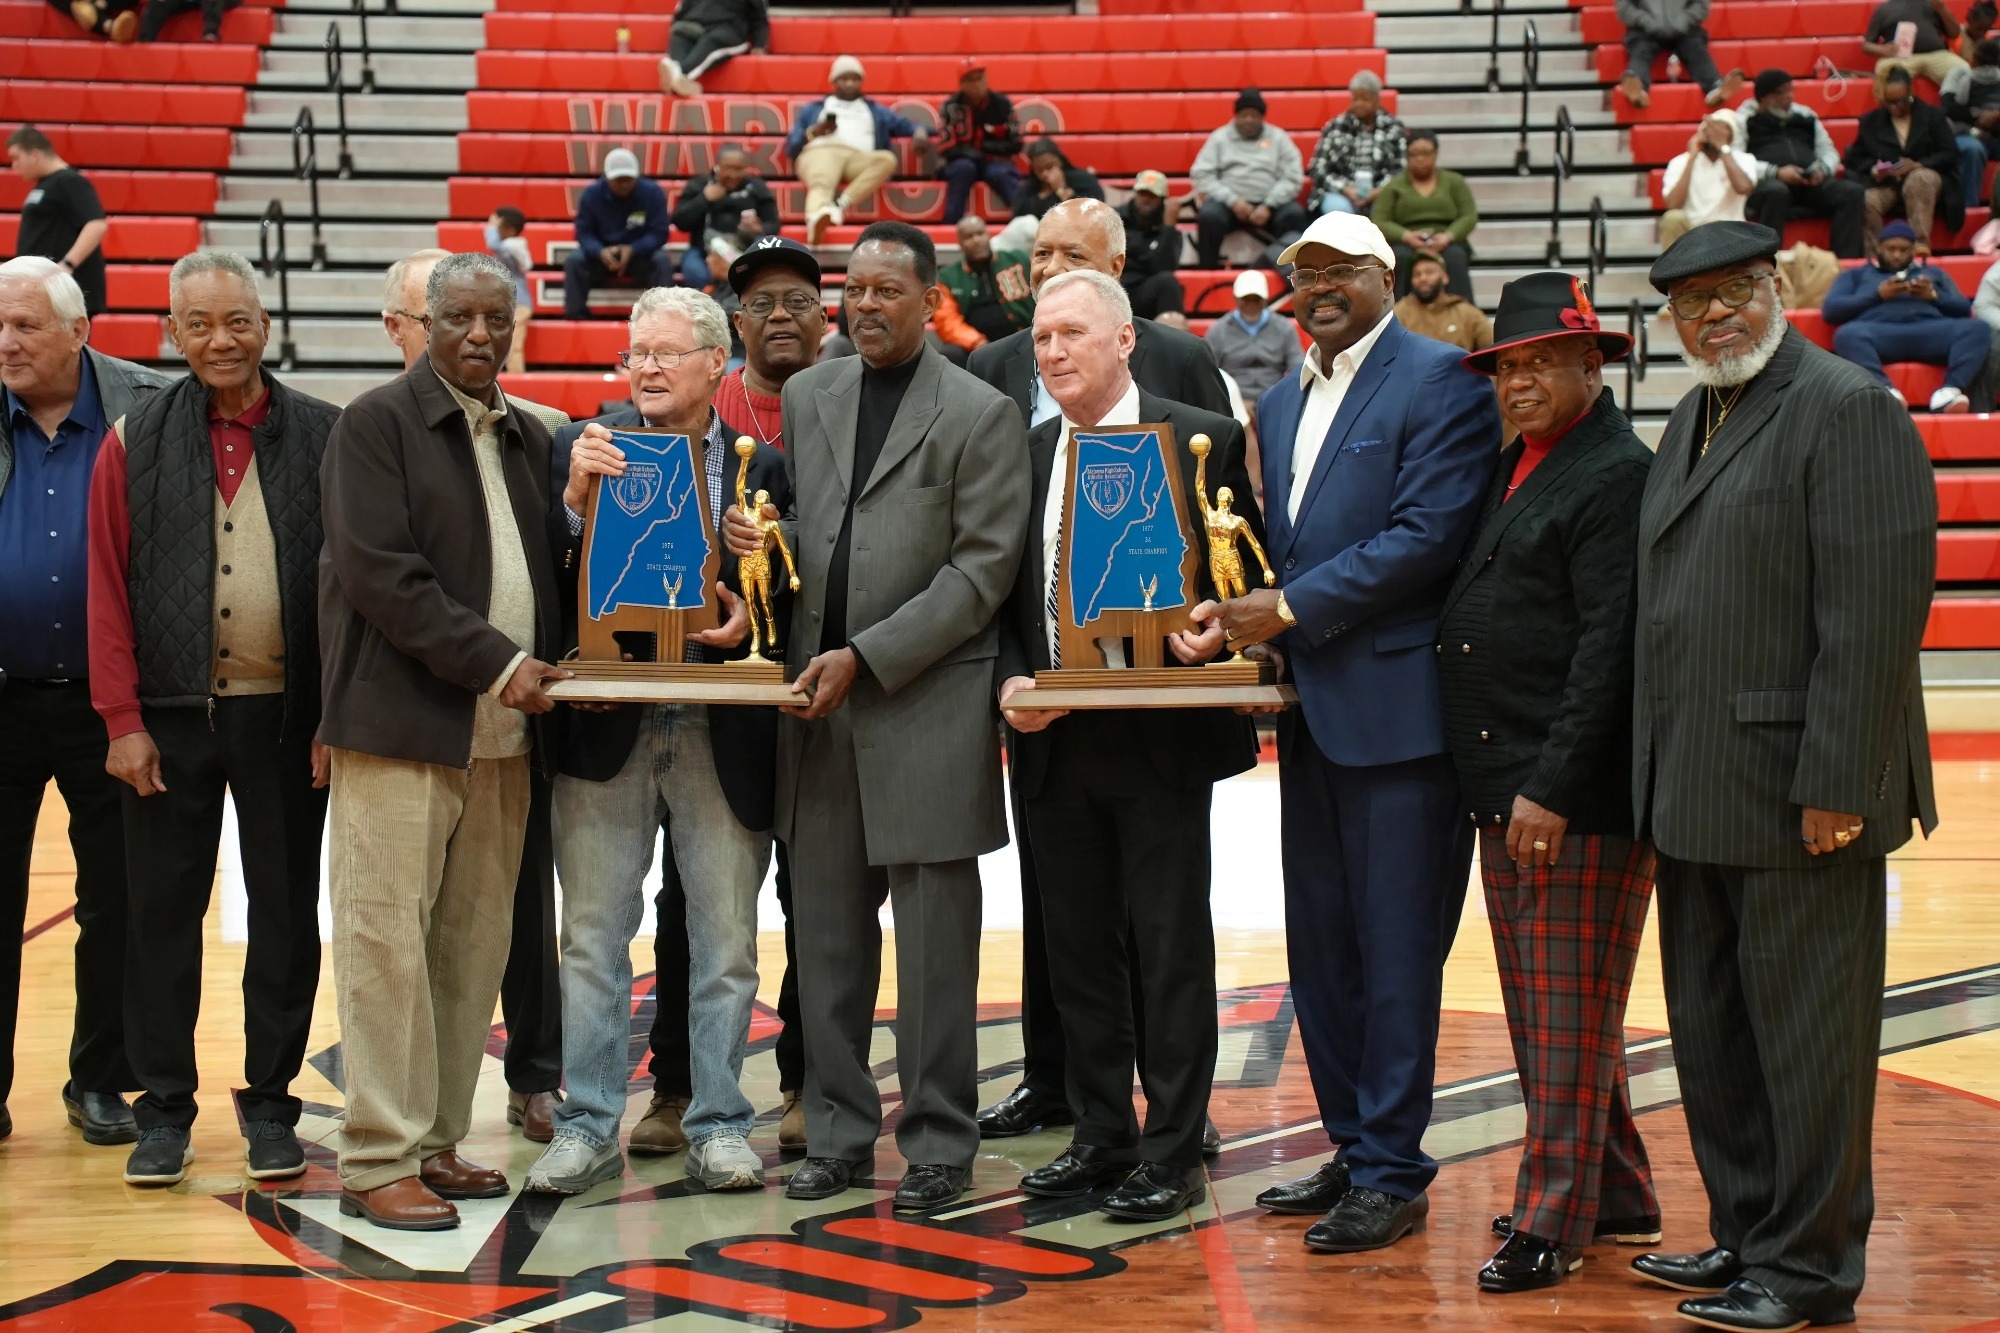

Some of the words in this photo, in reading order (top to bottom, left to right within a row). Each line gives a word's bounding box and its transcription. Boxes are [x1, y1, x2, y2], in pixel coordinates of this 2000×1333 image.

[1144, 547, 1168, 555] CHAMPION
[646, 563, 662, 571] STATE
[662, 564, 687, 572] CHAMPION
